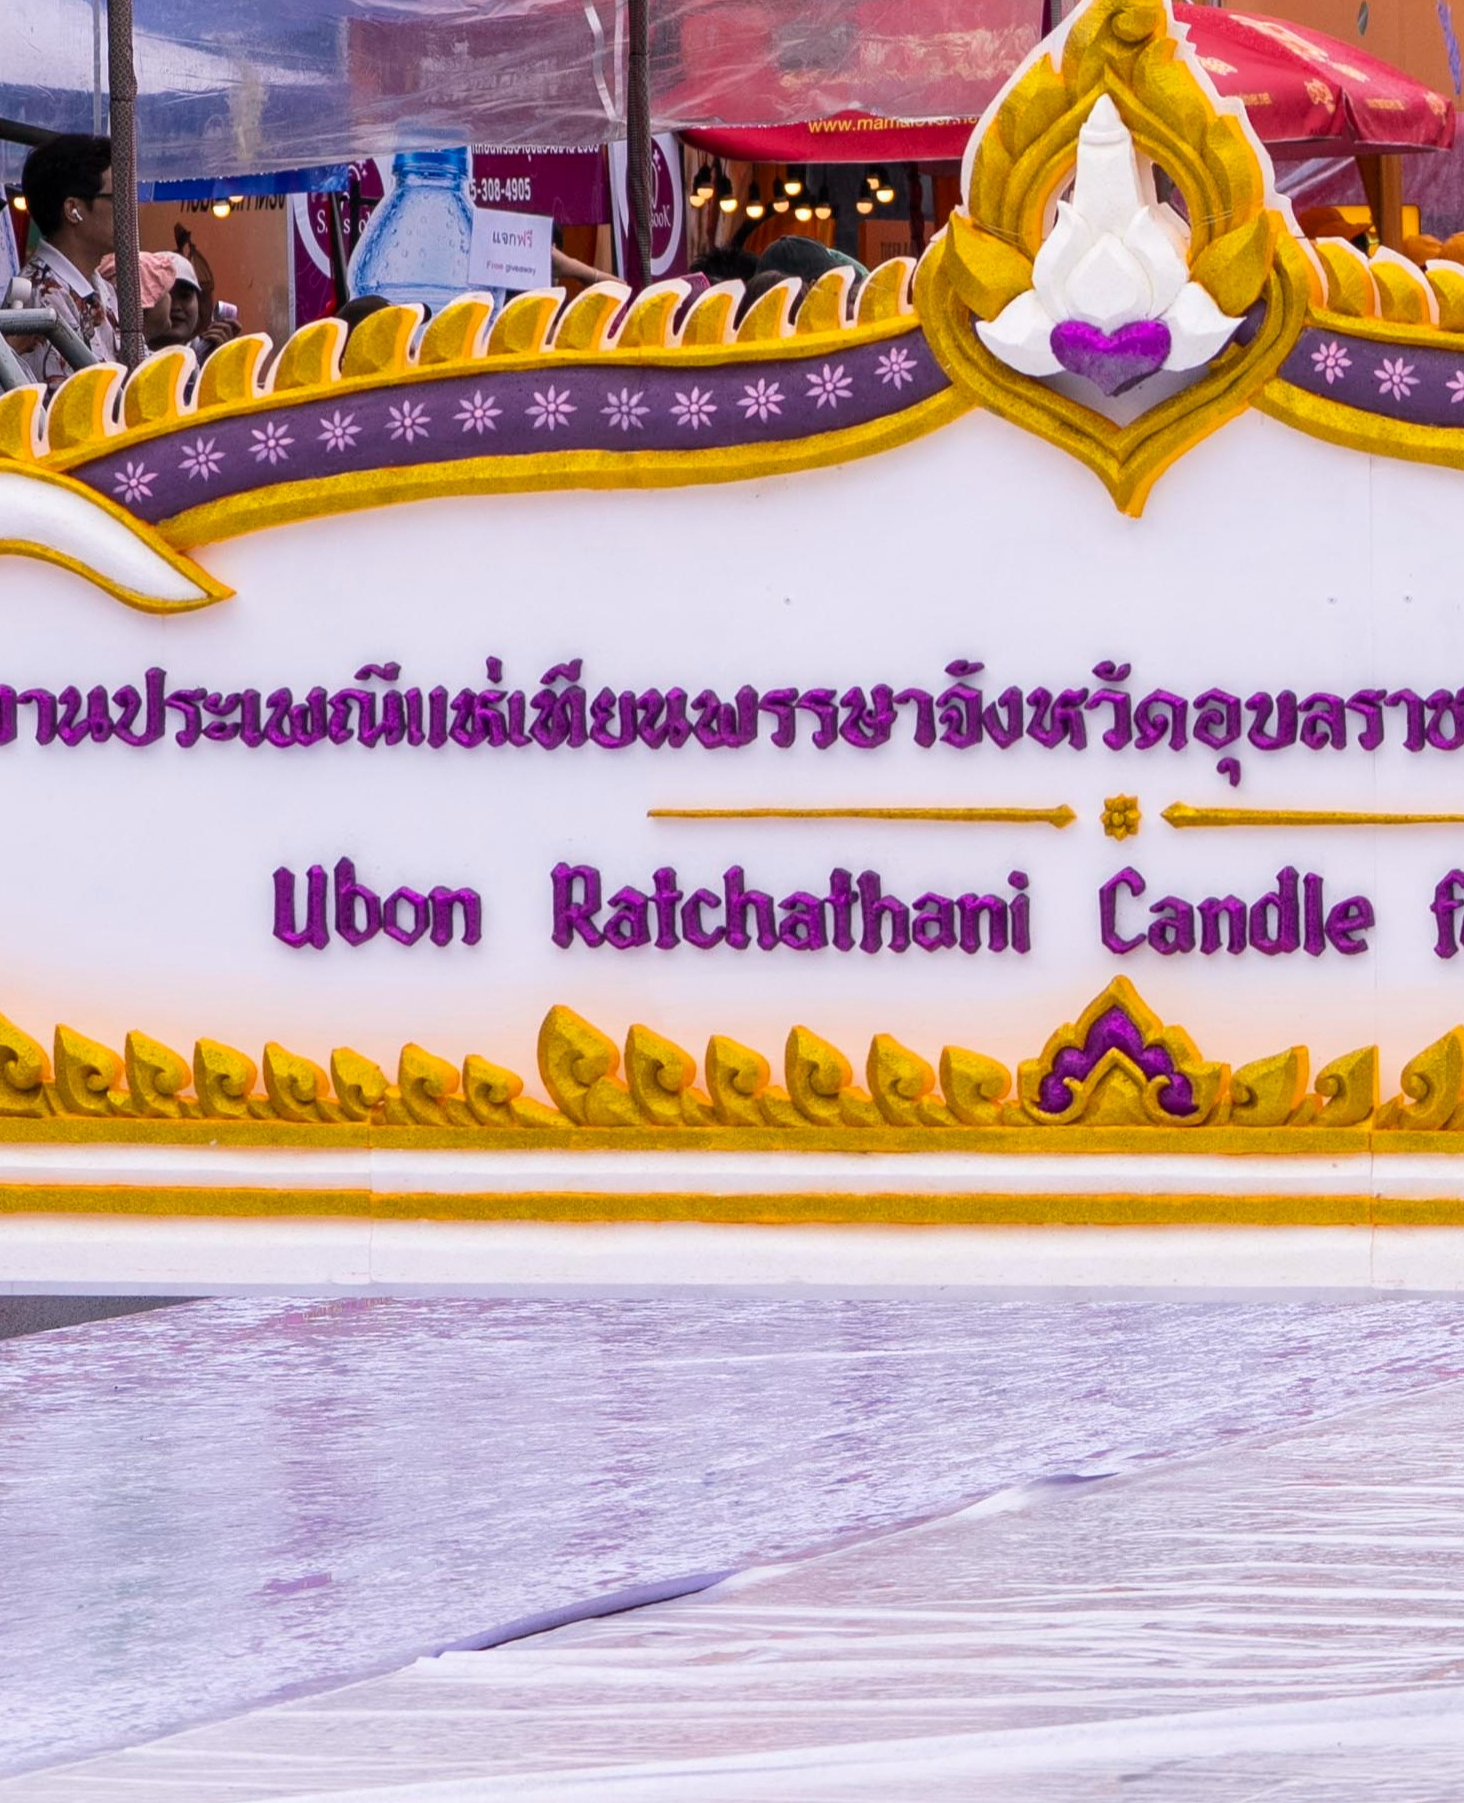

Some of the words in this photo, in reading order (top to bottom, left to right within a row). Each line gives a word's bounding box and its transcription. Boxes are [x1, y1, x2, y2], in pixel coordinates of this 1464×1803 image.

[469, 176, 532, 202] 5-308-4905
[492, 229, 534, 249] แจกฟรี
[486, 260, 504, 271] Free
[274, 857, 482, 952] Ubon
[551, 862, 1031, 956] Ratchathani
[1100, 867, 1375, 957] Candle
